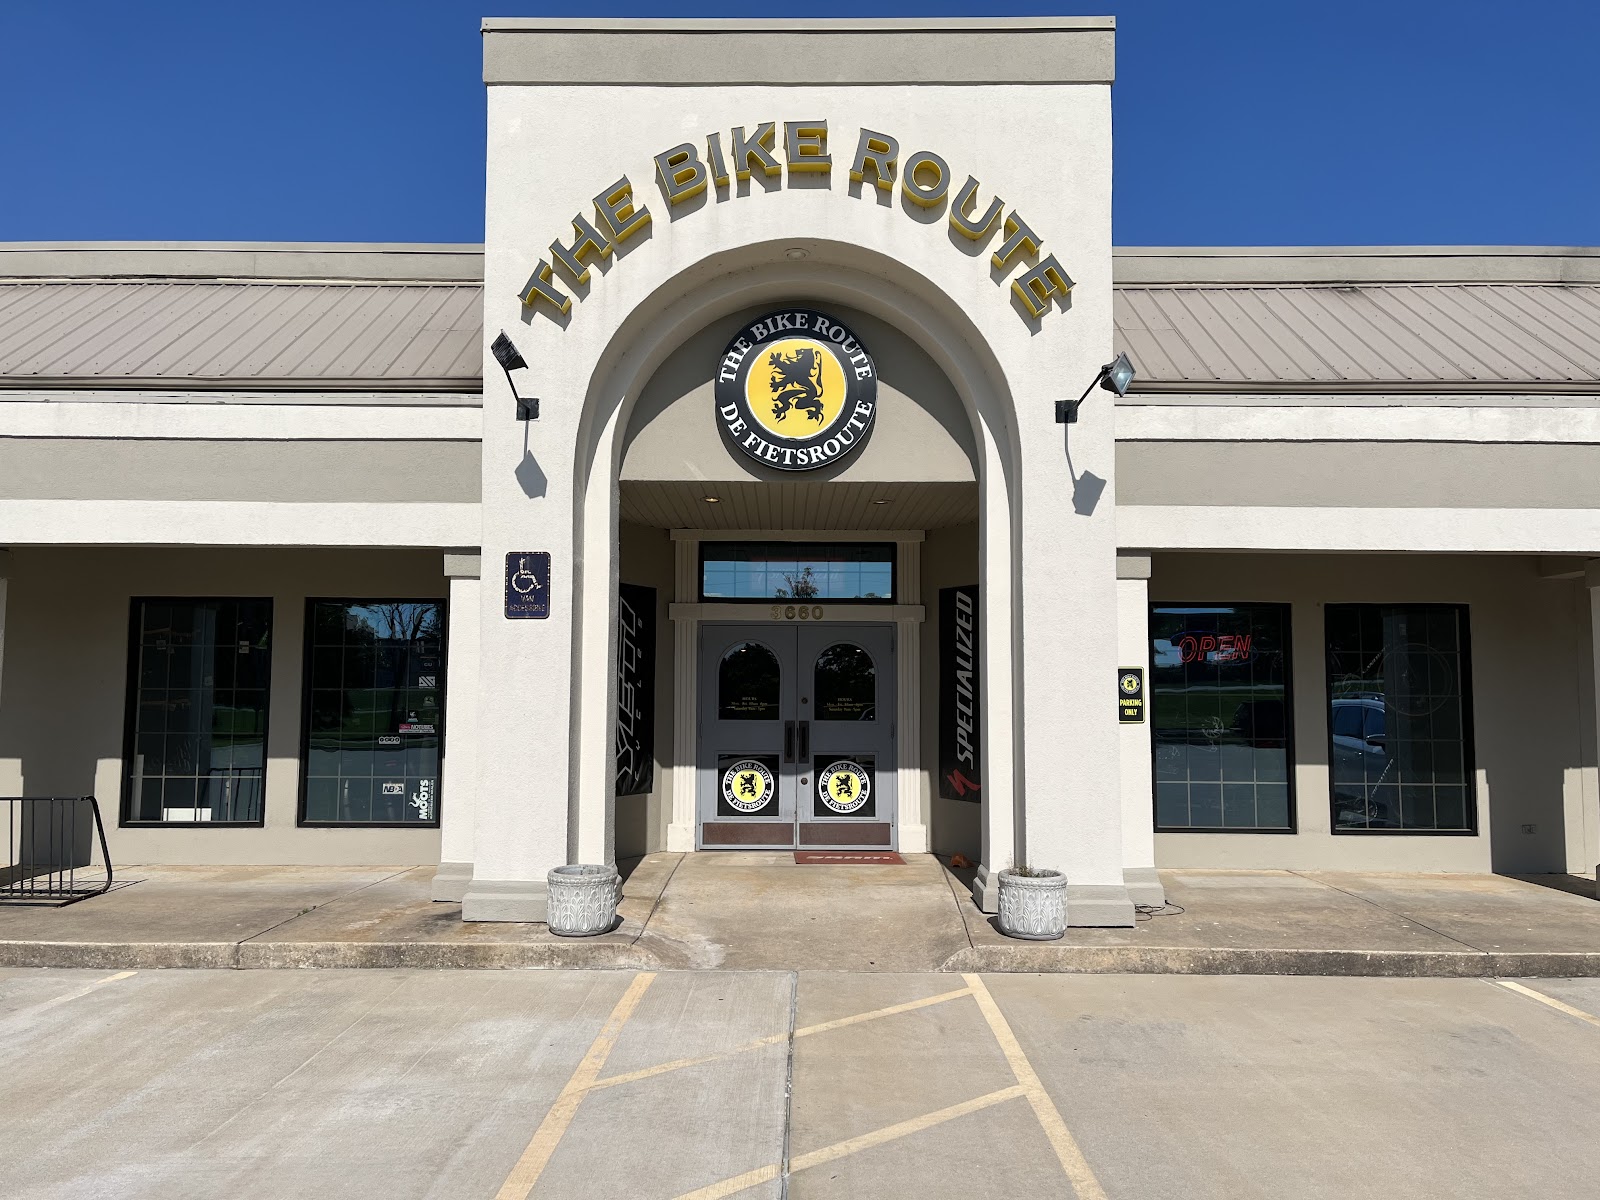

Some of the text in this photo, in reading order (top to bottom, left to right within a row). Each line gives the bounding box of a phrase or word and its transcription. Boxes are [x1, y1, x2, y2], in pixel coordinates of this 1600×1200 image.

[517, 119, 1077, 319] THE BIKE ROUTE
[719, 312, 873, 384] THE BIKE ROUTE
[719, 400, 873, 465] DE FIETSROUTE
[770, 605, 824, 620] 3660
[1177, 634, 1252, 663] OPEN
[956, 590, 974, 771] SPECIALIZED
[1119, 698, 1142, 707] PARKING
[1124, 708, 1138, 716] ONLY
[726, 763, 771, 785] THE BIKE ROUTE
[821, 763, 867, 787] THE BIKE ROUTE
[418, 779, 429, 820] MOOTS
